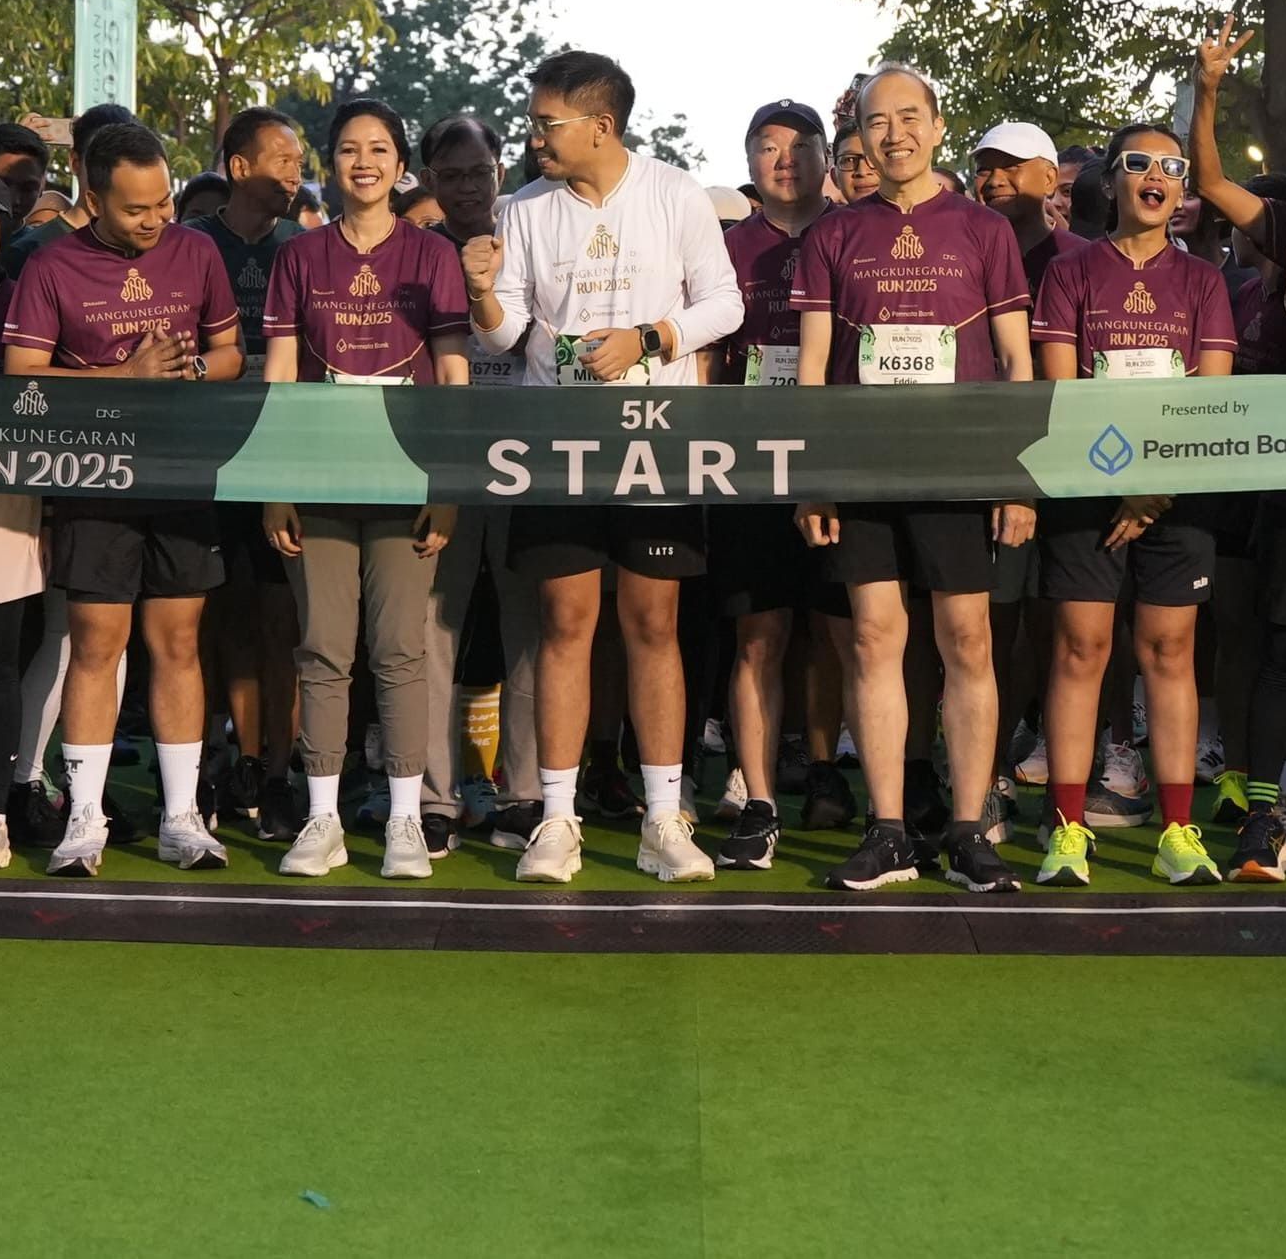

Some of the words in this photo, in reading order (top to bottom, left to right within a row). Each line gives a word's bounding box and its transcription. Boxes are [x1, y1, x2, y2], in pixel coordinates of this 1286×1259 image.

[853, 266, 963, 280] MANGKUNEGARAN
[576, 280, 602, 295] RUN
[603, 277, 631, 291] 2025
[876, 279, 904, 293] RUN
[905, 279, 938, 293] 2025
[84, 304, 191, 324] MANGKUNEGARAN
[335, 313, 362, 326] RUN
[362, 311, 393, 325] 2025
[111, 321, 139, 336] RUN
[140, 317, 172, 334] 2025
[1086, 320, 1189, 336] MANGKUNEGARAN
[1109, 333, 1137, 346] RUN
[1138, 333, 1169, 348] 2025
[861, 353, 872, 362] 5K
[878, 355, 935, 371] K6368
[620, 399, 672, 431] 5K
[1161, 401, 1228, 416] Presented
[1232, 400, 1250, 417] by
[1142, 435, 1250, 460] Permata
[24, 450, 135, 491] 2025
[485, 438, 806, 497] START
[648, 546, 674, 556] LATS
